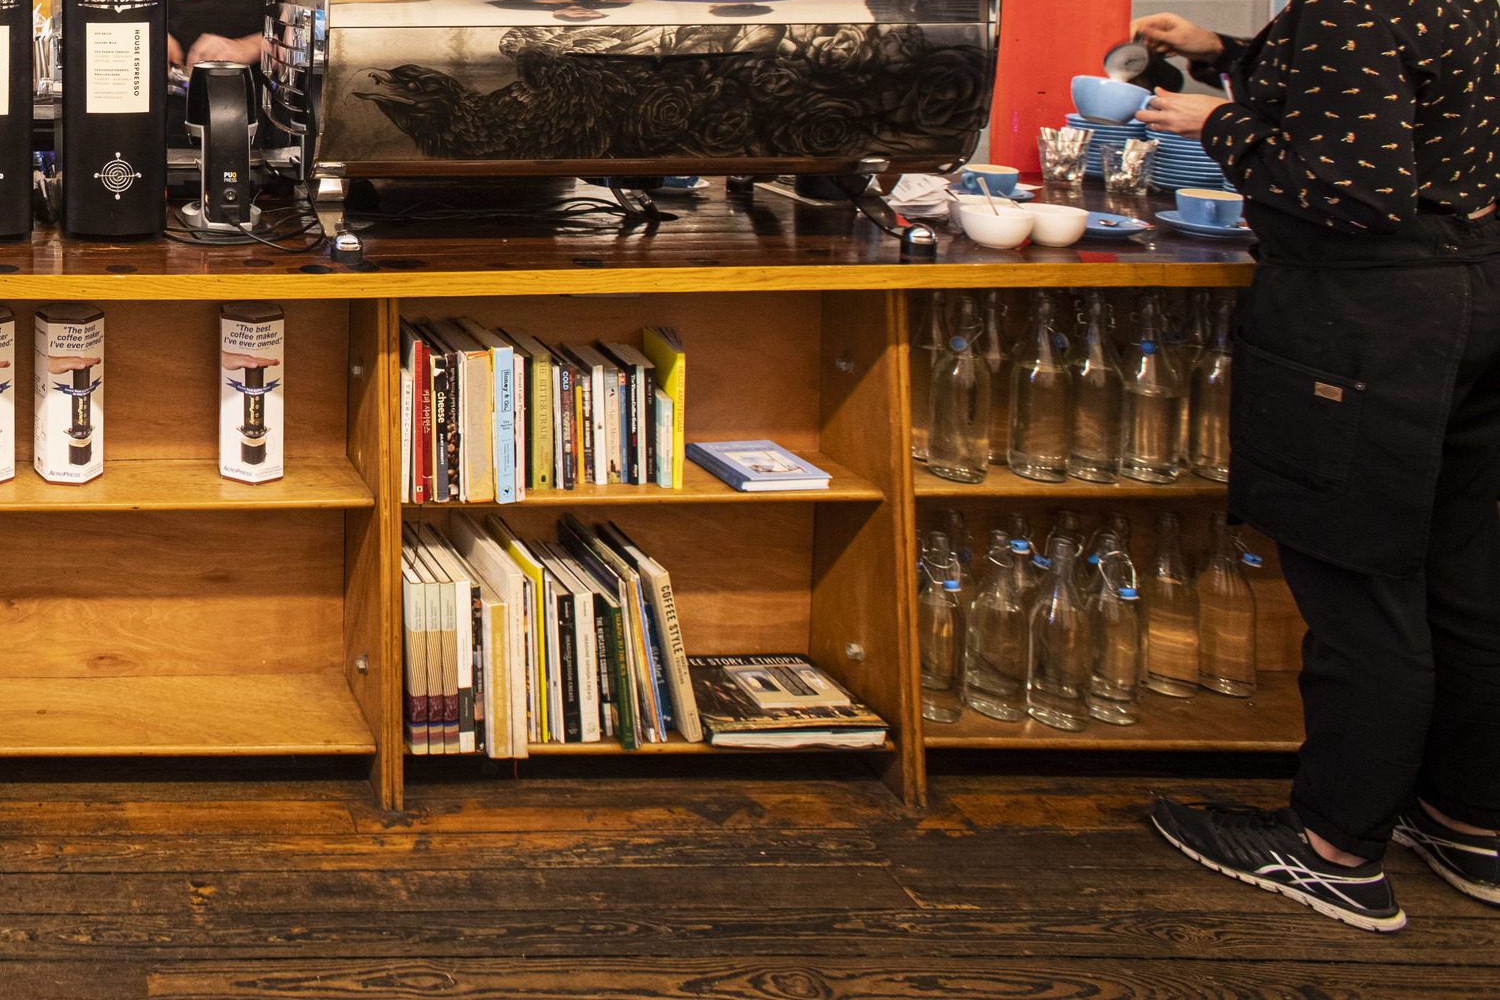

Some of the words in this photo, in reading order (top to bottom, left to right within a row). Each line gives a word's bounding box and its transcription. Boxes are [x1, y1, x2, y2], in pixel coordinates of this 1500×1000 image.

[57, 333, 83, 341] coffee
[84, 331, 100, 341] maker
[84, 324, 96, 334] best
[230, 331, 254, 340] coffee
[256, 331, 278, 339] maker
[256, 324, 271, 333] best
[50, 341, 64, 349] I've
[224, 337, 237, 345] I've
[539, 358, 547, 376] THE
[503, 370, 511, 392] Honey
[539, 379, 547, 411] BITTER
[437, 391, 446, 424] cheese
[609, 408, 617, 420] Age
[676, 389, 684, 433] AMSTERDAM
[539, 413, 548, 442] TRADE
[615, 613, 623, 639] TALKING
[660, 584, 677, 623] COFFEE
[669, 624, 683, 654] STYLE
[597, 627, 606, 658] NEWCASTLE
[750, 656, 805, 665] ETHIOPIA
